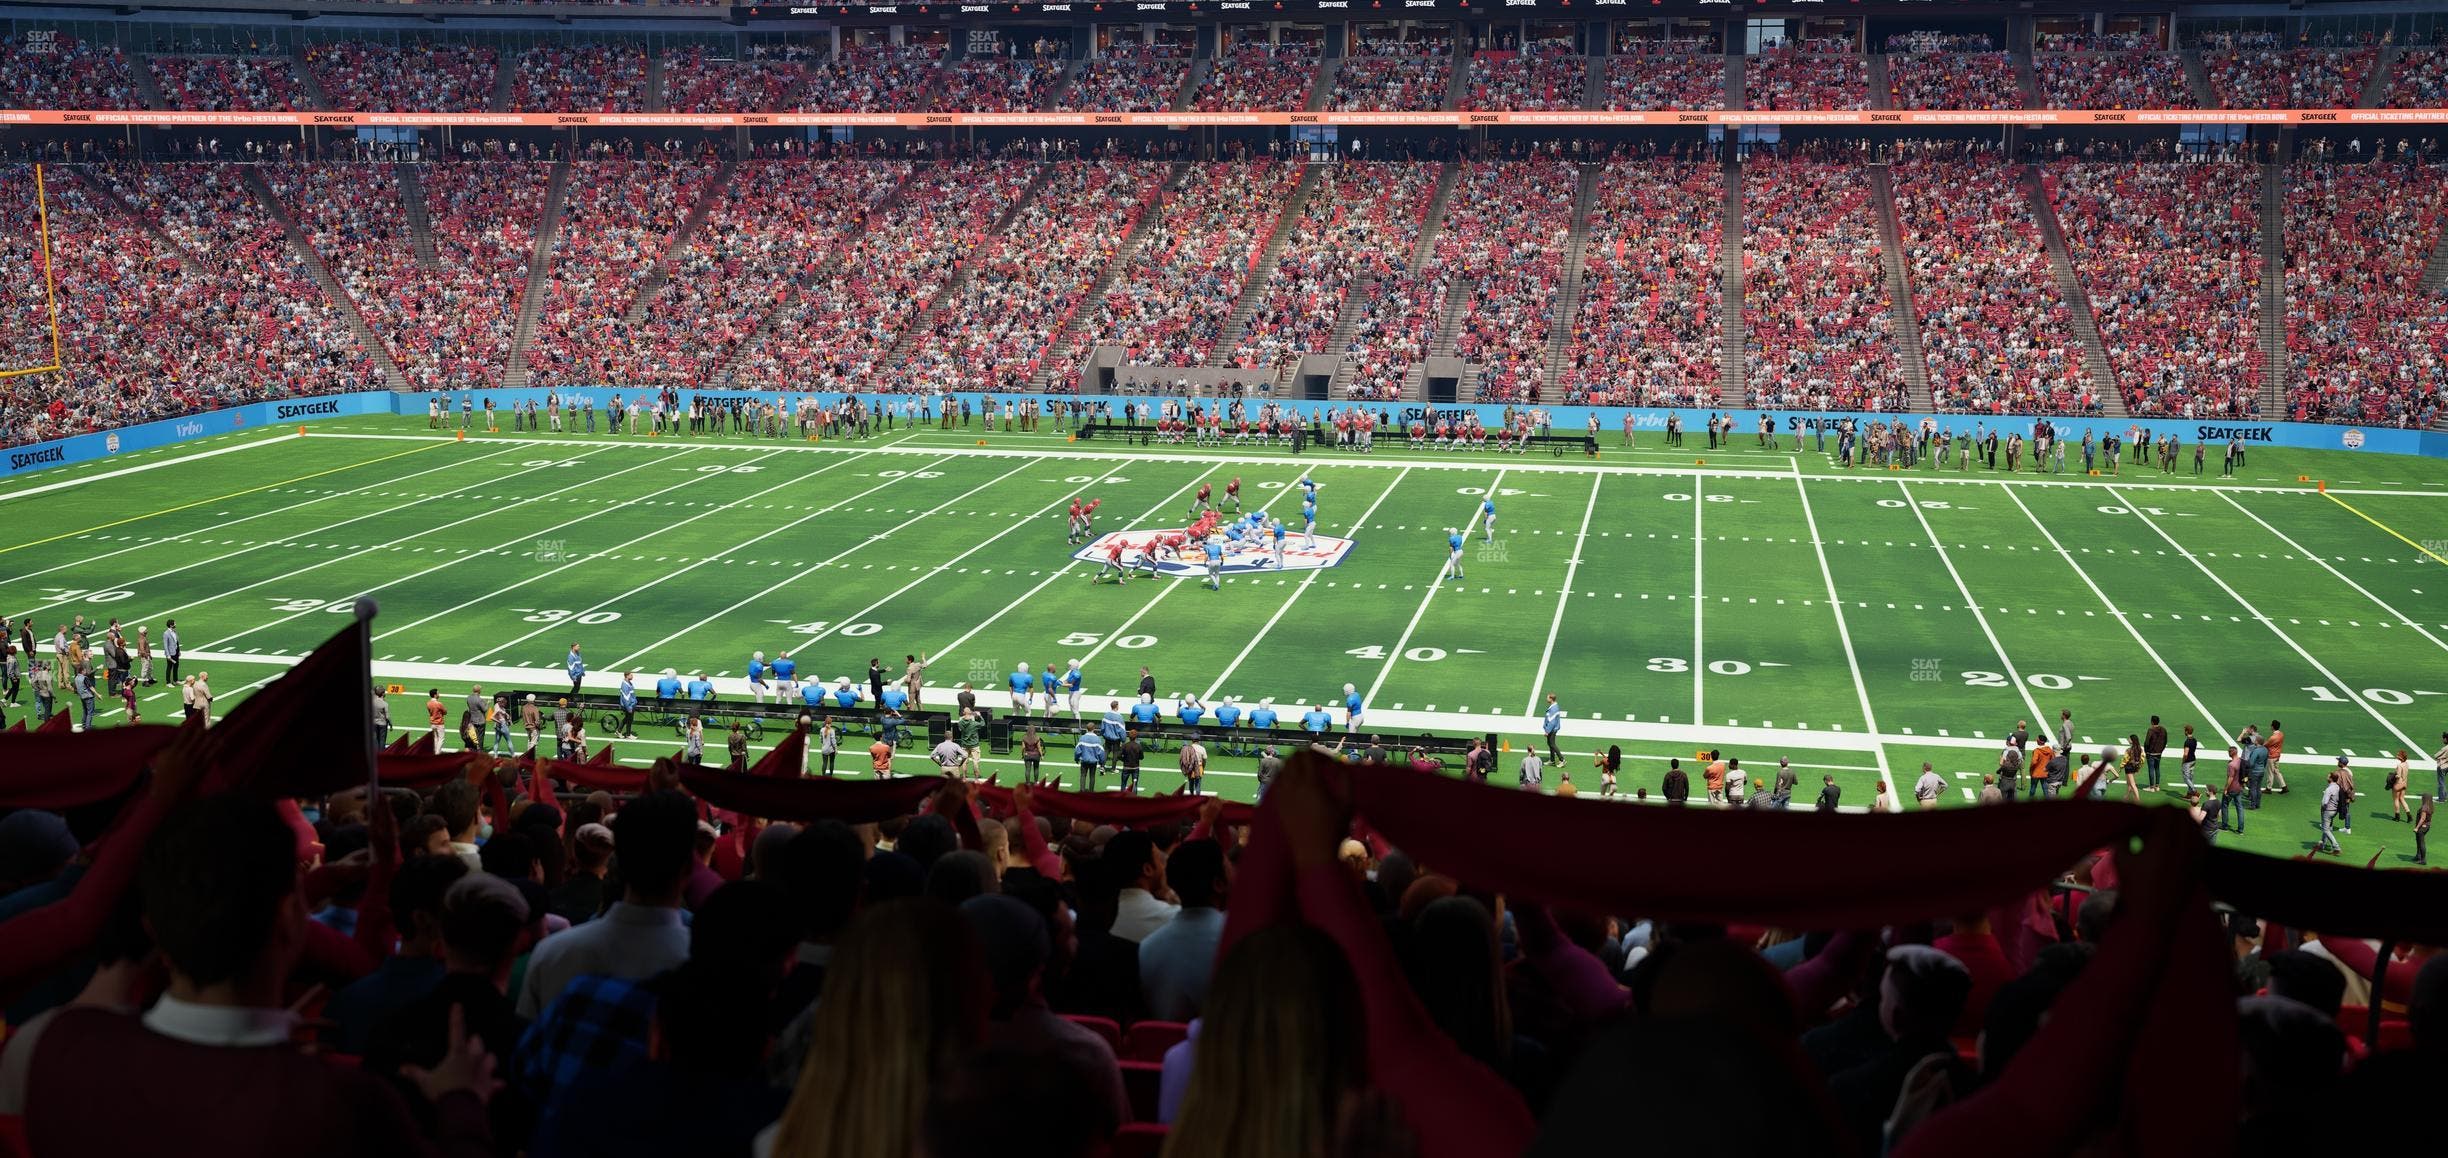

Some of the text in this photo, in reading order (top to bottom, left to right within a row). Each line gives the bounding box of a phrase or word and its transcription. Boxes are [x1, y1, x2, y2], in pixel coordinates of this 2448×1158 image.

[96, 114, 129, 122] OFFICIAL
[131, 114, 171, 122] TICKETING
[171, 114, 207, 122] PARTNER
[252, 115, 276, 123] FIESTA
[277, 115, 299, 123] BOWL
[2094, 113, 2125, 121] SEATGEEK
[2301, 113, 2337, 121] SEATGEEK
[278, 400, 338, 419] SEATGEEK
[699, 396, 750, 408] EATGEEK
[176, 420, 203, 438] Vrbo
[1789, 416, 1858, 432] SAGEK
[2198, 426, 2272, 442] SEATGEEK
[11, 444, 64, 470] SEATGEEK
[522, 610, 622, 624] 30
[787, 621, 883, 636] 40
[1057, 633, 1158, 649] 50
[1345, 645, 1447, 662] 40
[1646, 658, 1751, 675] 30
[1961, 671, 2073, 690] 20
[2300, 686, 2414, 705] 10
[1701, 753, 1711, 761] 30
